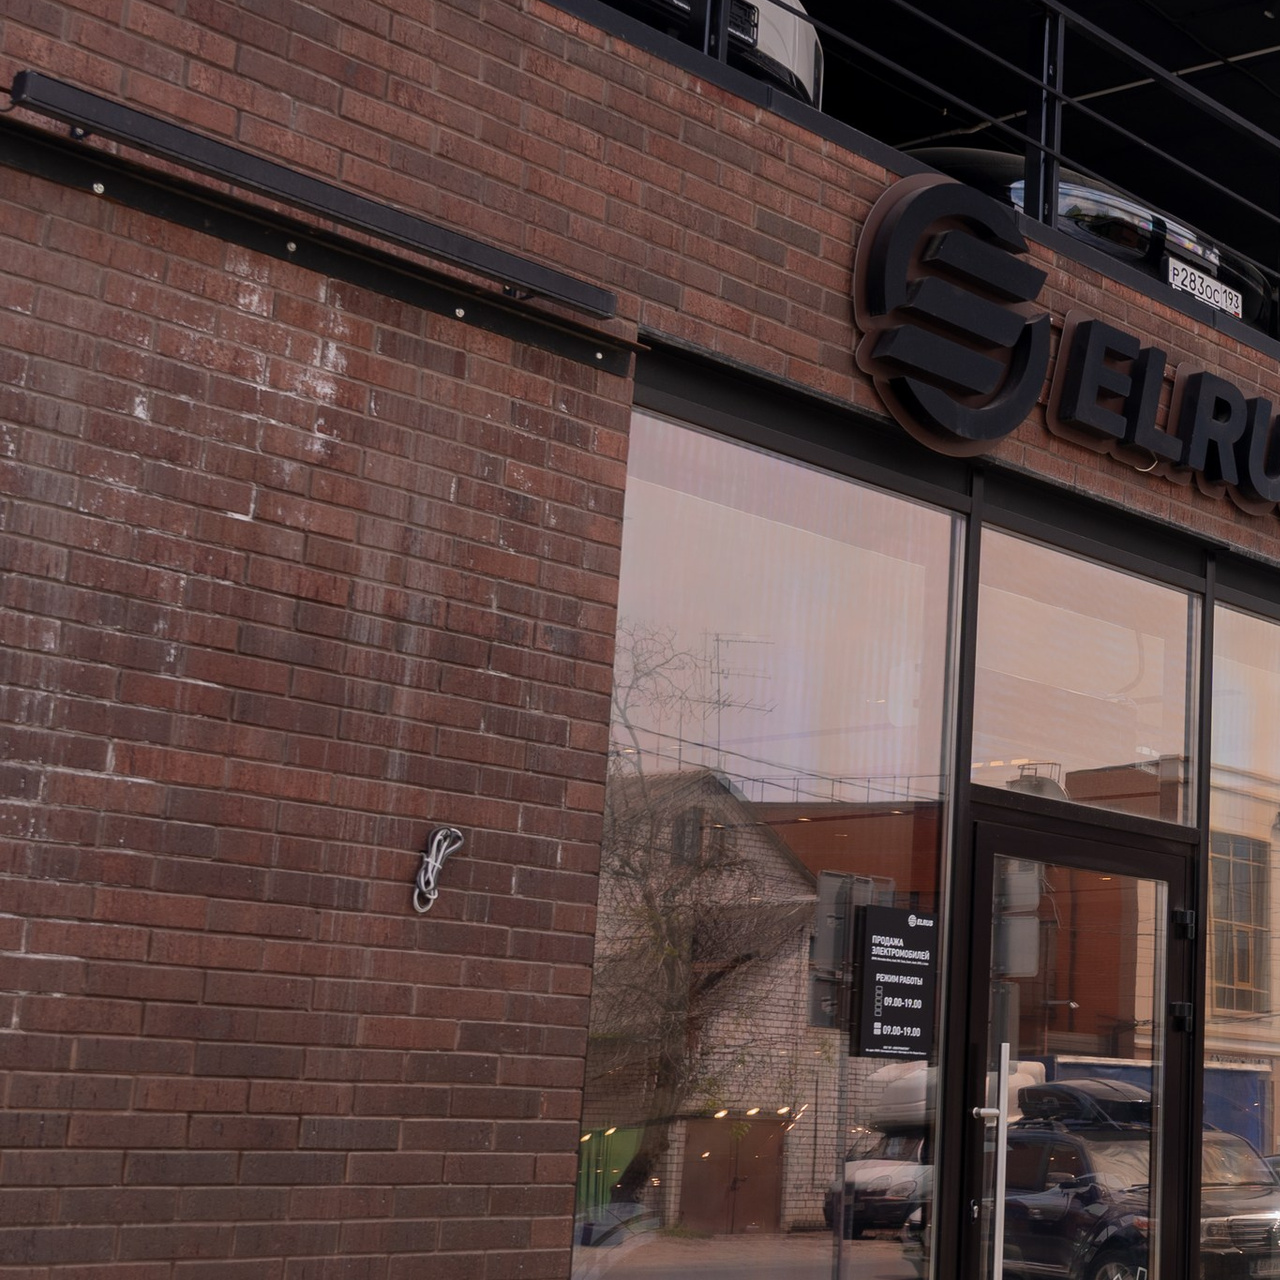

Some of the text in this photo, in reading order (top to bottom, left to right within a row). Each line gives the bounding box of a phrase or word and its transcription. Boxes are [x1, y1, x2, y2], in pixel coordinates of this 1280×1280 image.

[1223, 289, 1240, 309] 193
[872, 935, 904, 947] ПРОДАЖА
[871, 946, 930, 961] ЭЛЕКТРОМОБИЛЕЙ
[876, 973, 923, 986] РЕЖИМ РАБОТЫ
[884, 997, 922, 1009] 09.00-19.00
[882, 1025, 921, 1037] 09.00-19.00
